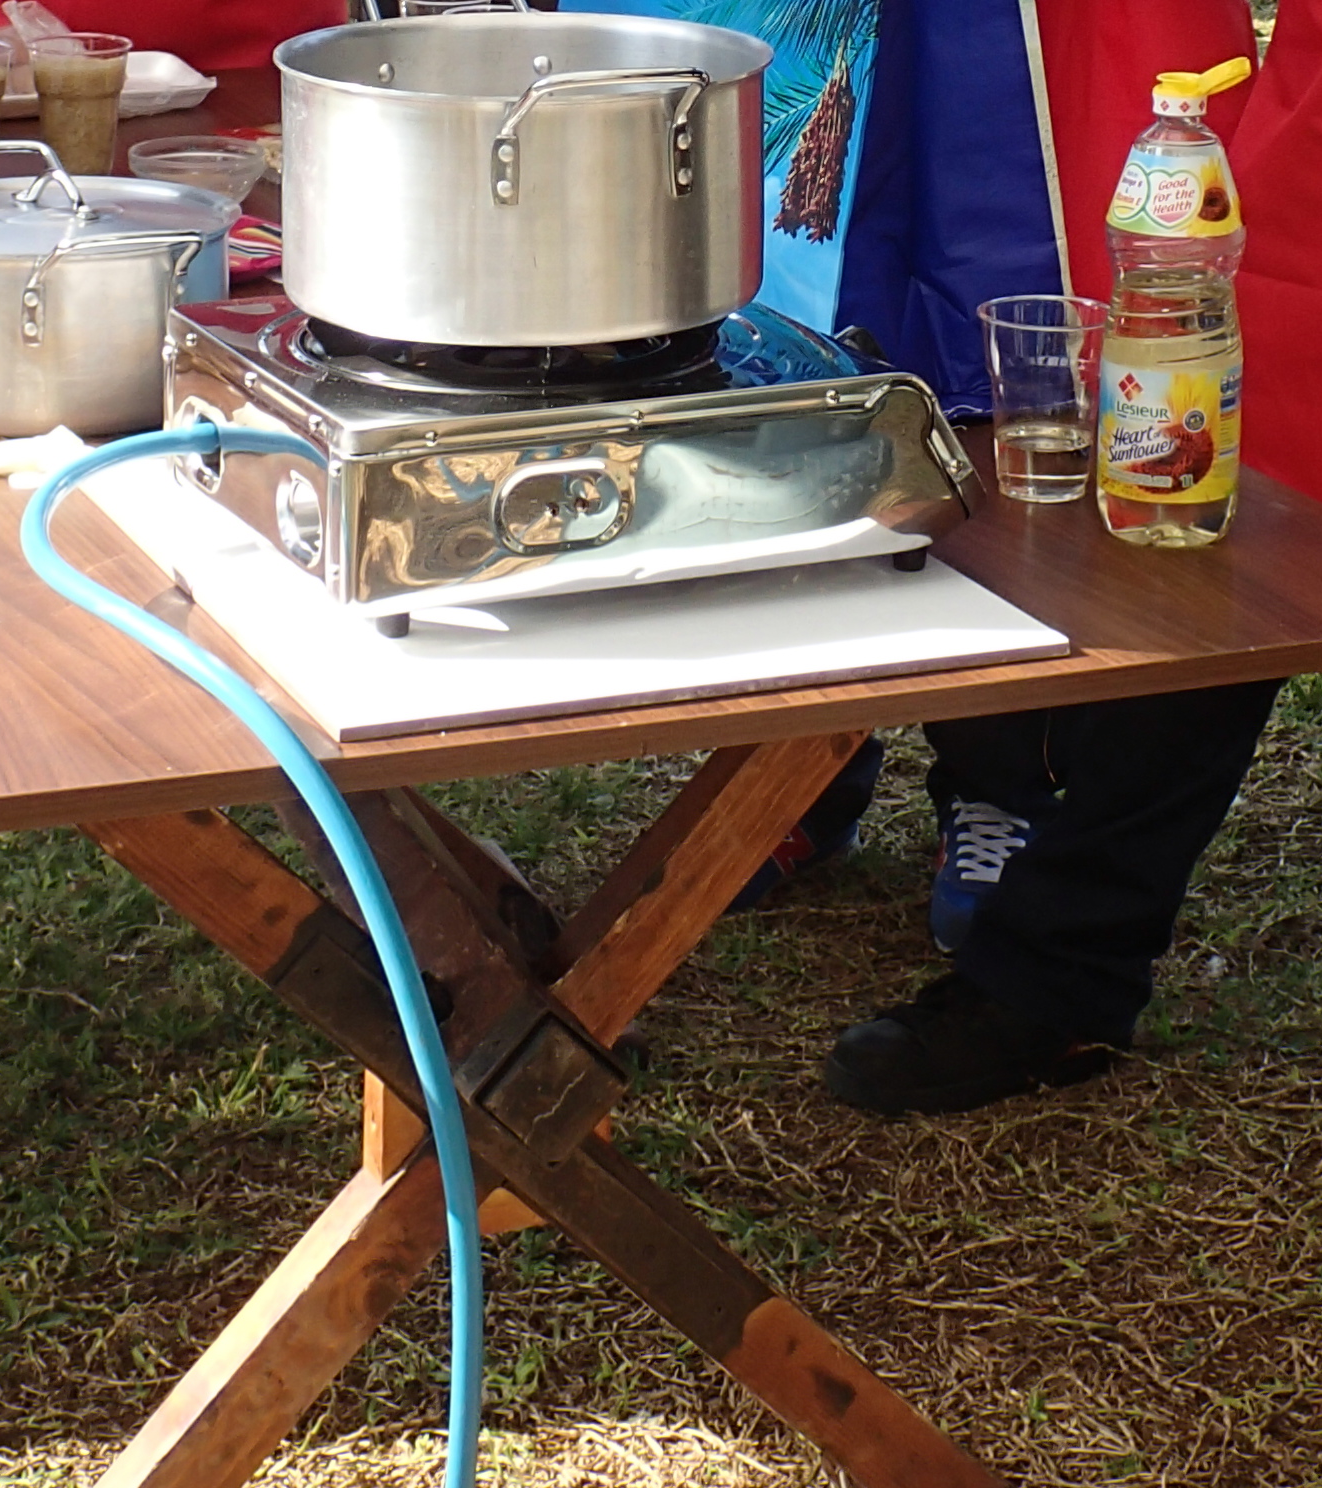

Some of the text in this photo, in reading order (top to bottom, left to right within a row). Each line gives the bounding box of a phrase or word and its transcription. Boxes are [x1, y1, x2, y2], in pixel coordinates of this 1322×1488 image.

[1158, 178, 1188, 191] Good
[1153, 189, 1195, 205] for the
[1153, 201, 1192, 215] Health
[1112, 426, 1153, 446] Heart
[1108, 440, 1175, 463] Sunflower
